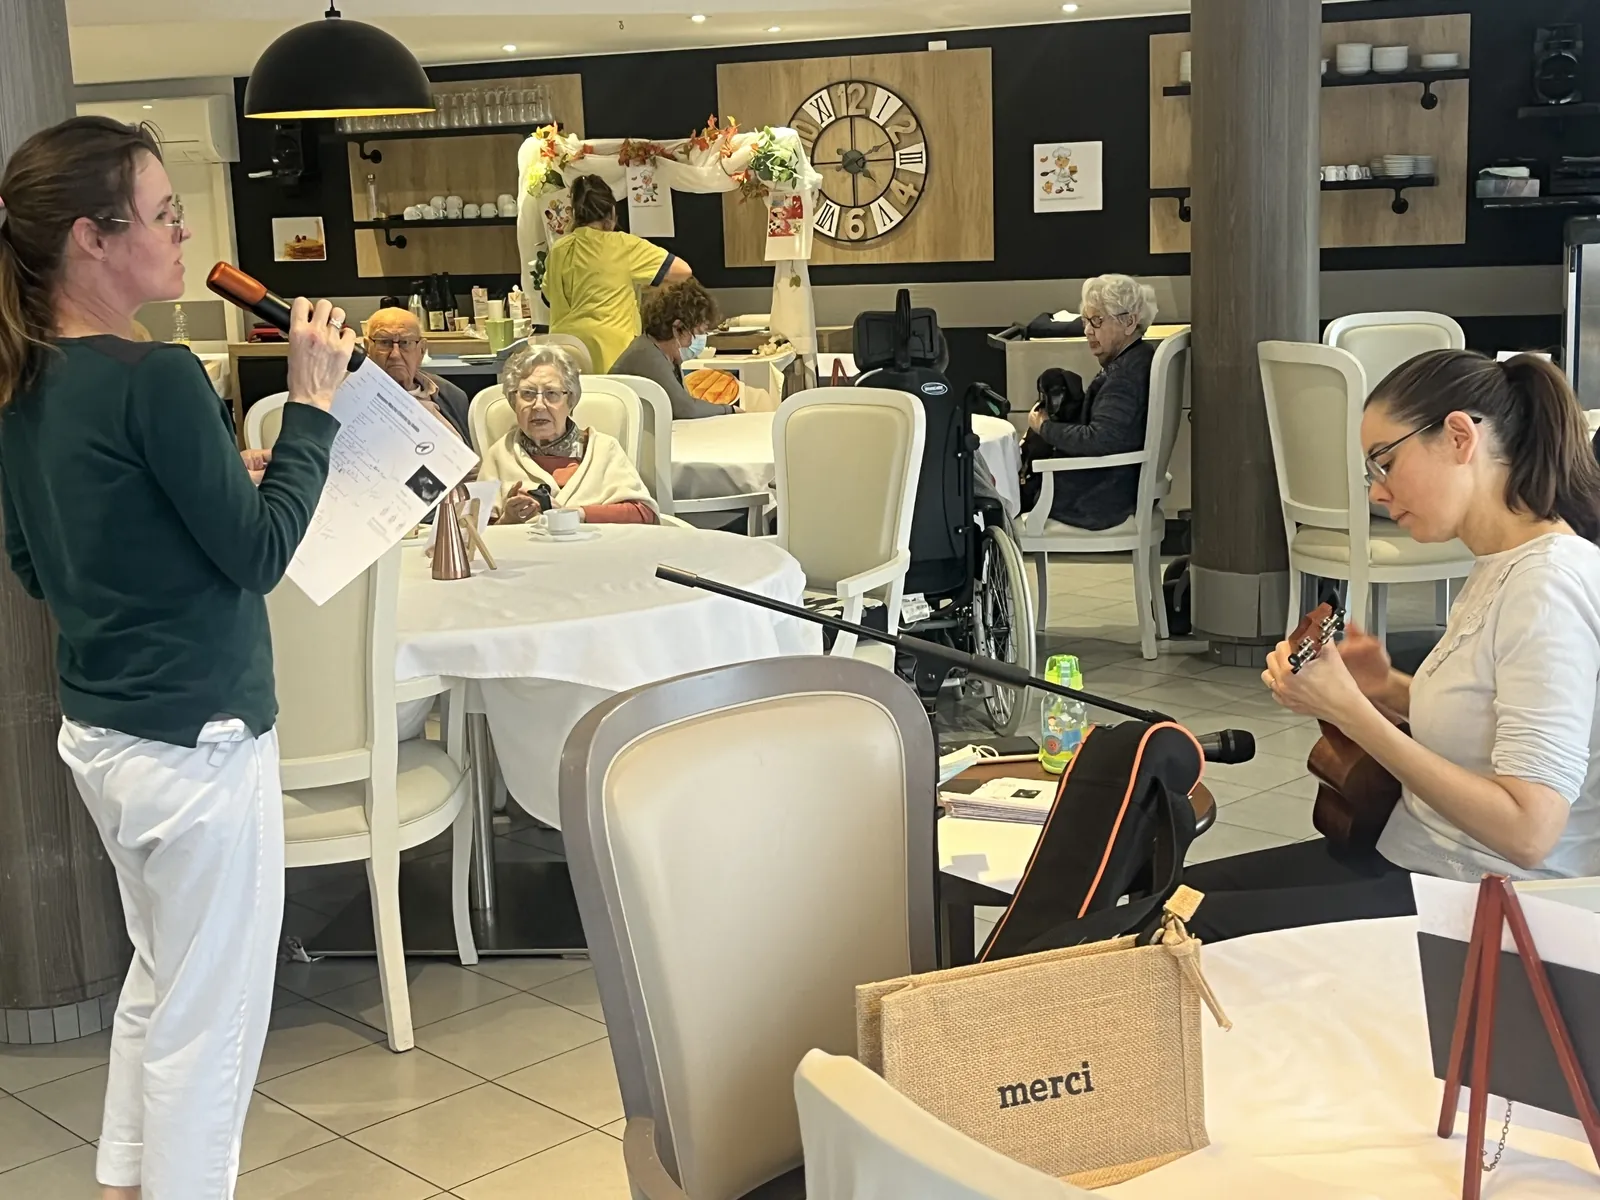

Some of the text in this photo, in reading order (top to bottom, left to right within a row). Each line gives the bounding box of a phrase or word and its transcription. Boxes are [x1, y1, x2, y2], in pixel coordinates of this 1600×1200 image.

[810, 94, 833, 125] XI
[838, 83, 866, 116] 12
[887, 114, 917, 145] 2
[899, 151, 923, 166] III
[889, 178, 919, 206] 4
[845, 207, 866, 240] 6
[997, 1060, 1095, 1109] merci
